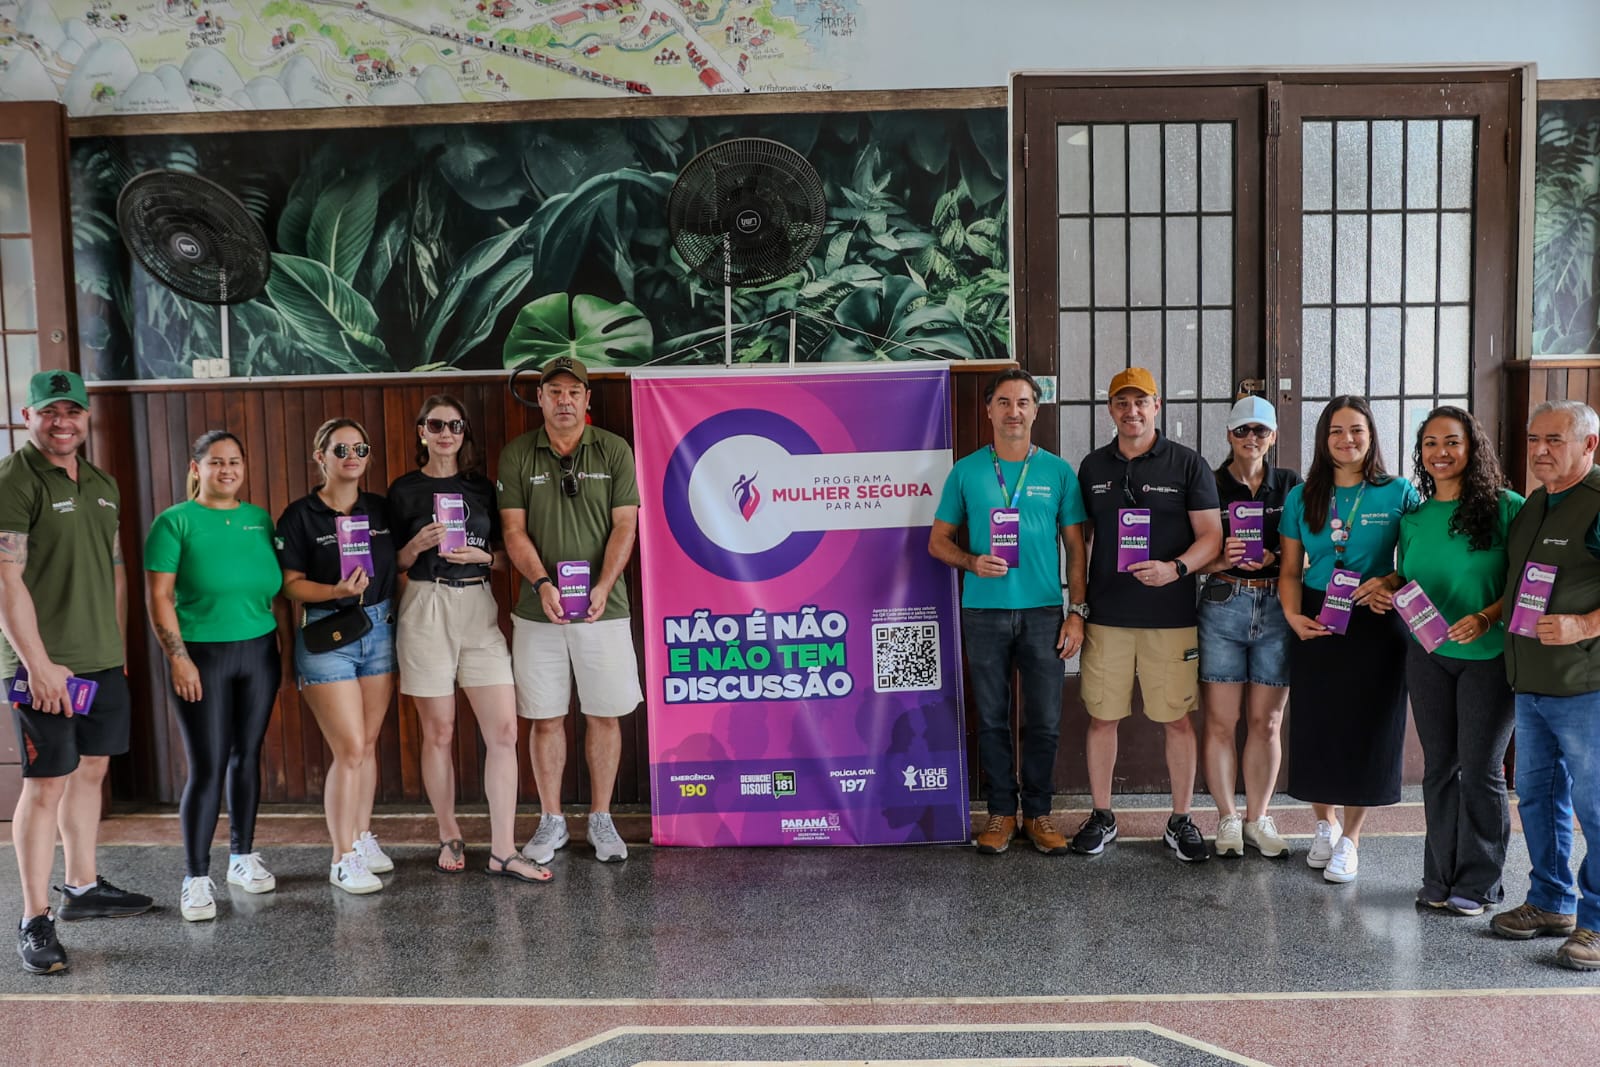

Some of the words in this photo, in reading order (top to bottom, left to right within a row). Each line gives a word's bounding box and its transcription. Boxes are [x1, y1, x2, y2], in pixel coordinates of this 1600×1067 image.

[814, 475, 891, 485] PROGRAMA
[772, 485, 850, 502] MULHER
[856, 483, 933, 499] SEGURA
[826, 500, 882, 511] PARANÁ
[665, 611, 739, 643] NÃO
[749, 609, 767, 641] É
[773, 606, 847, 639] NÃO
[670, 648, 691, 672] E
[697, 640, 771, 672] NÃO
[777, 642, 845, 669] TEM
[665, 667, 853, 702] DISCUSSÃO
[670, 773, 715, 782] EMERGÊNCIA
[829, 769, 857, 777] POLÍCIA
[858, 768, 876, 776] CIVIL
[919, 767, 947, 776] LIGUE
[775, 780, 793, 791] 181
[840, 779, 866, 792] 197
[919, 775, 948, 788] 180
[679, 784, 707, 797] 190
[740, 783, 771, 796] DISQUE
[781, 816, 828, 828] PARANÁ
